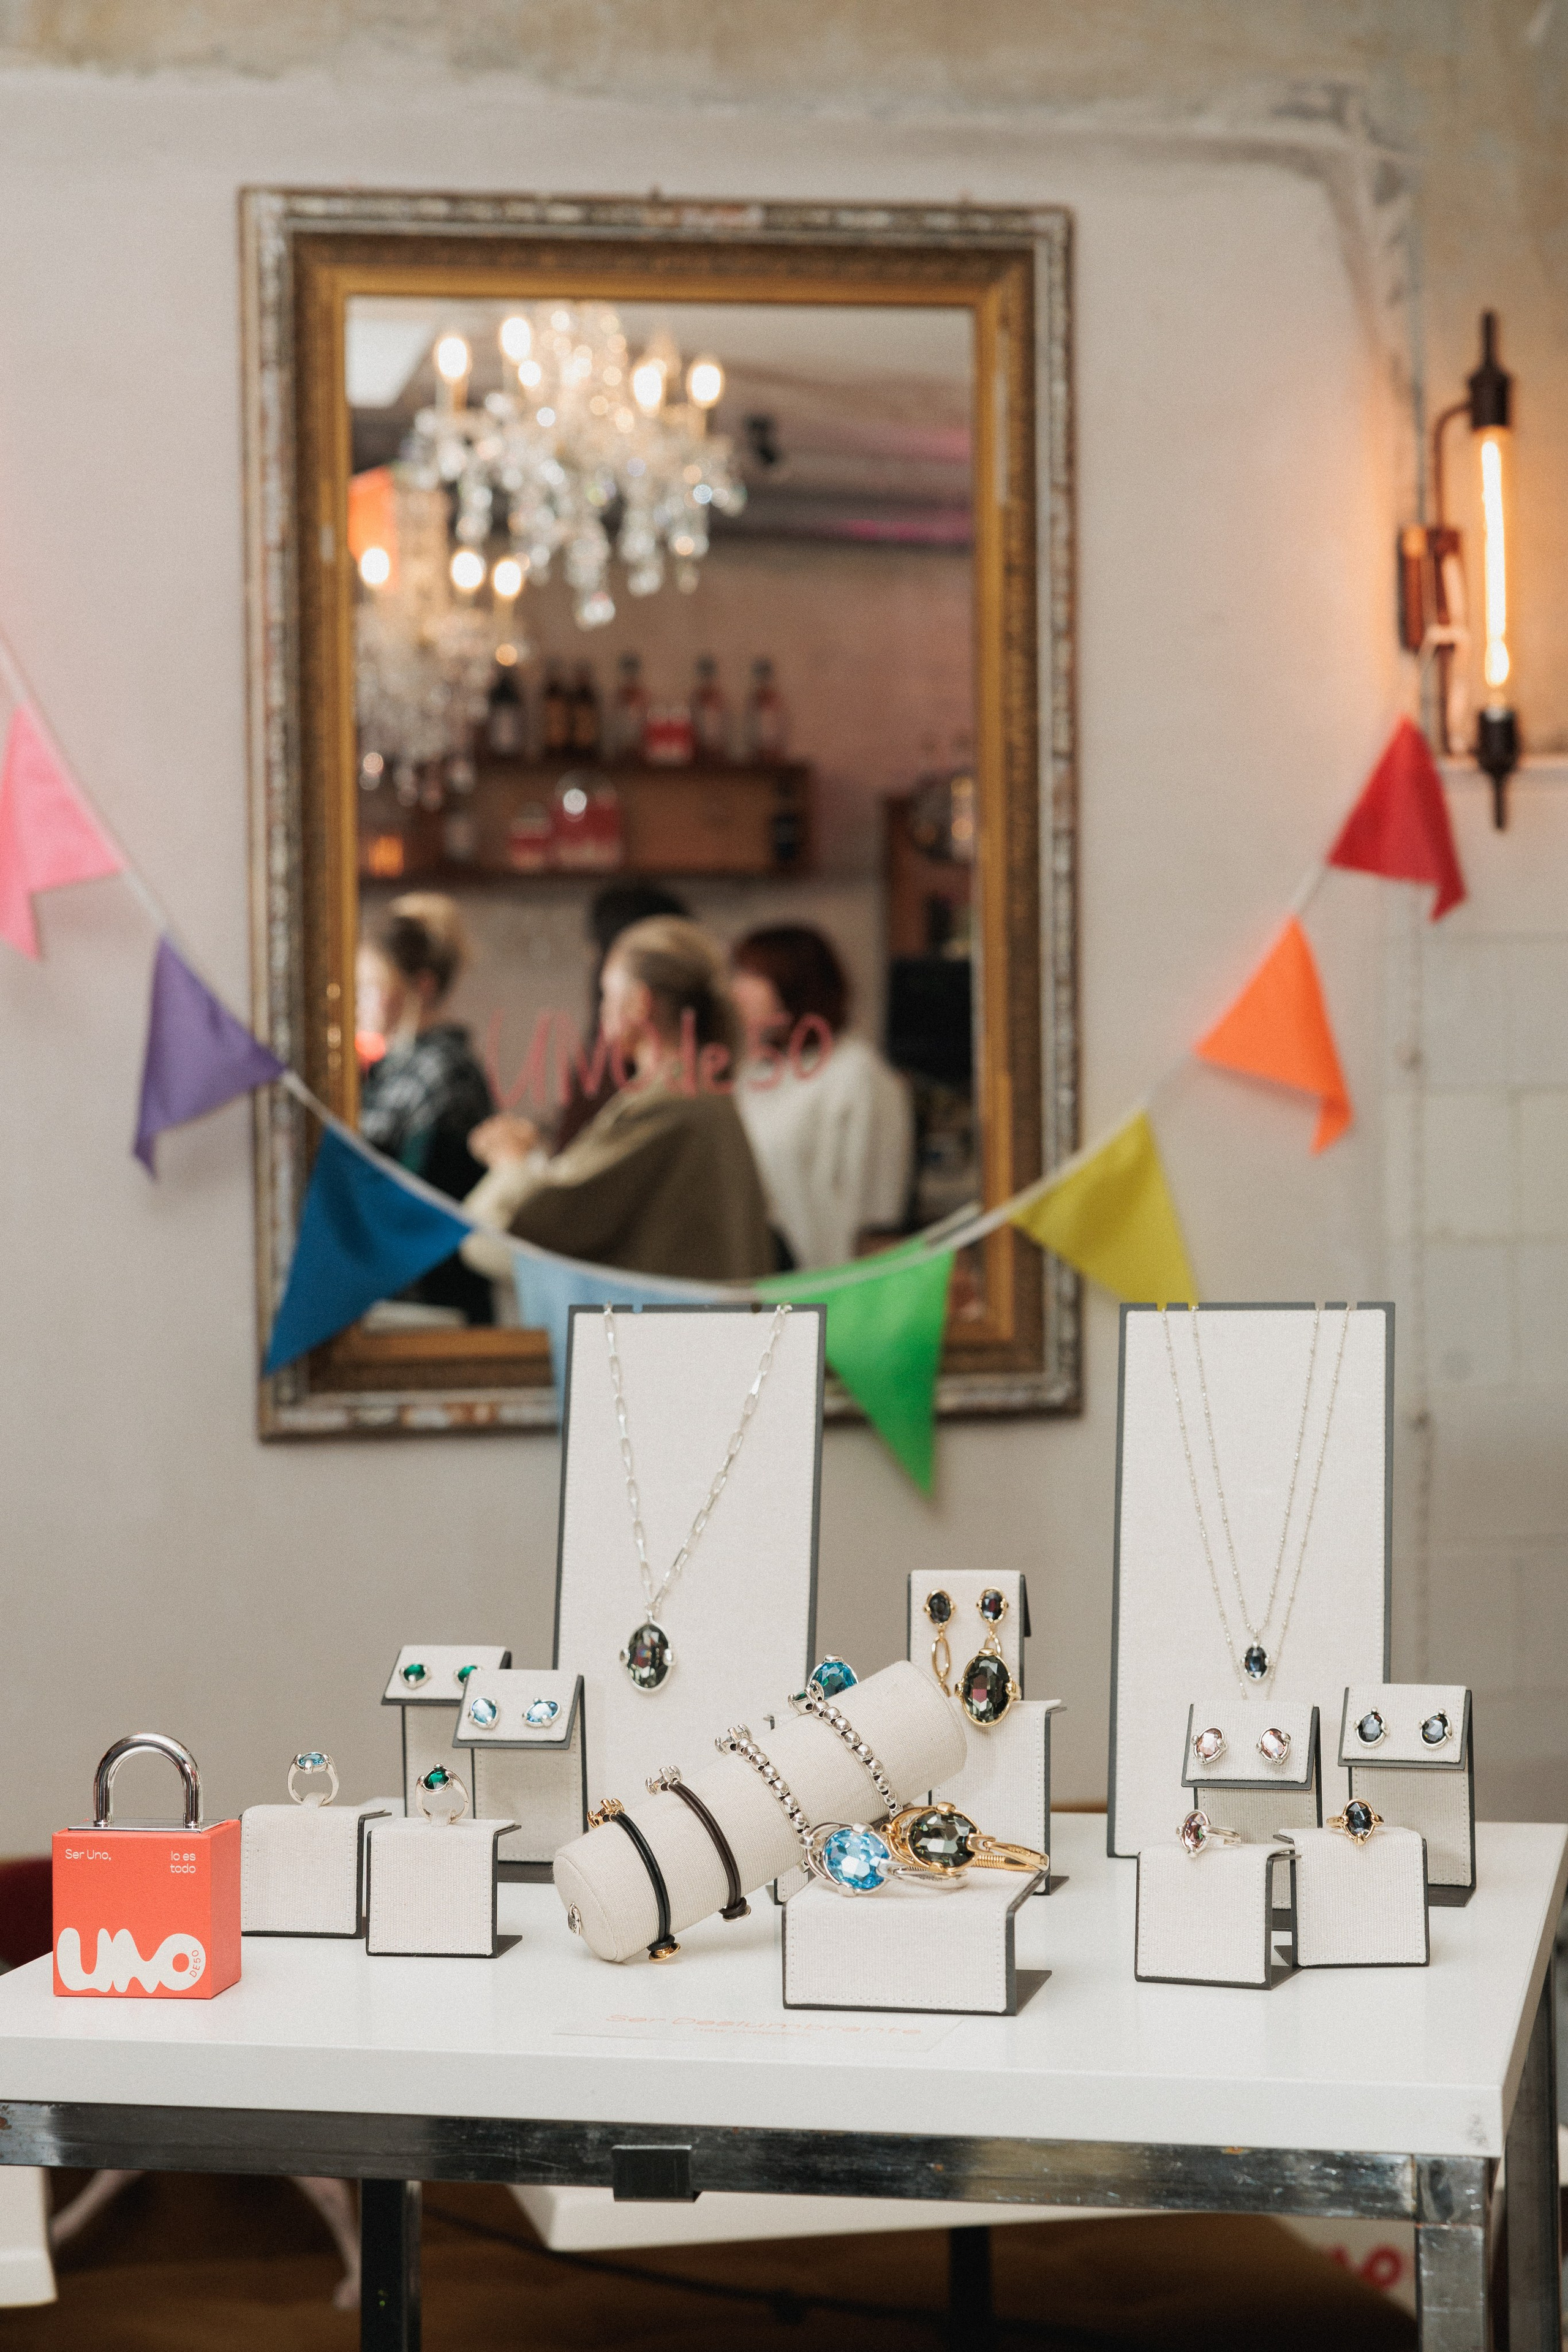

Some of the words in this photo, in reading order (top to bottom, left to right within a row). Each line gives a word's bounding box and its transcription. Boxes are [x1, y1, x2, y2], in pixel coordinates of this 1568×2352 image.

[65, 1849, 85, 1860] Ser
[87, 1850, 111, 1861] Uno,
[170, 1851, 180, 1861] lo
[183, 1853, 196, 1861] es
[170, 1864, 196, 1874] todo
[57, 1927, 206, 1994] UNO
